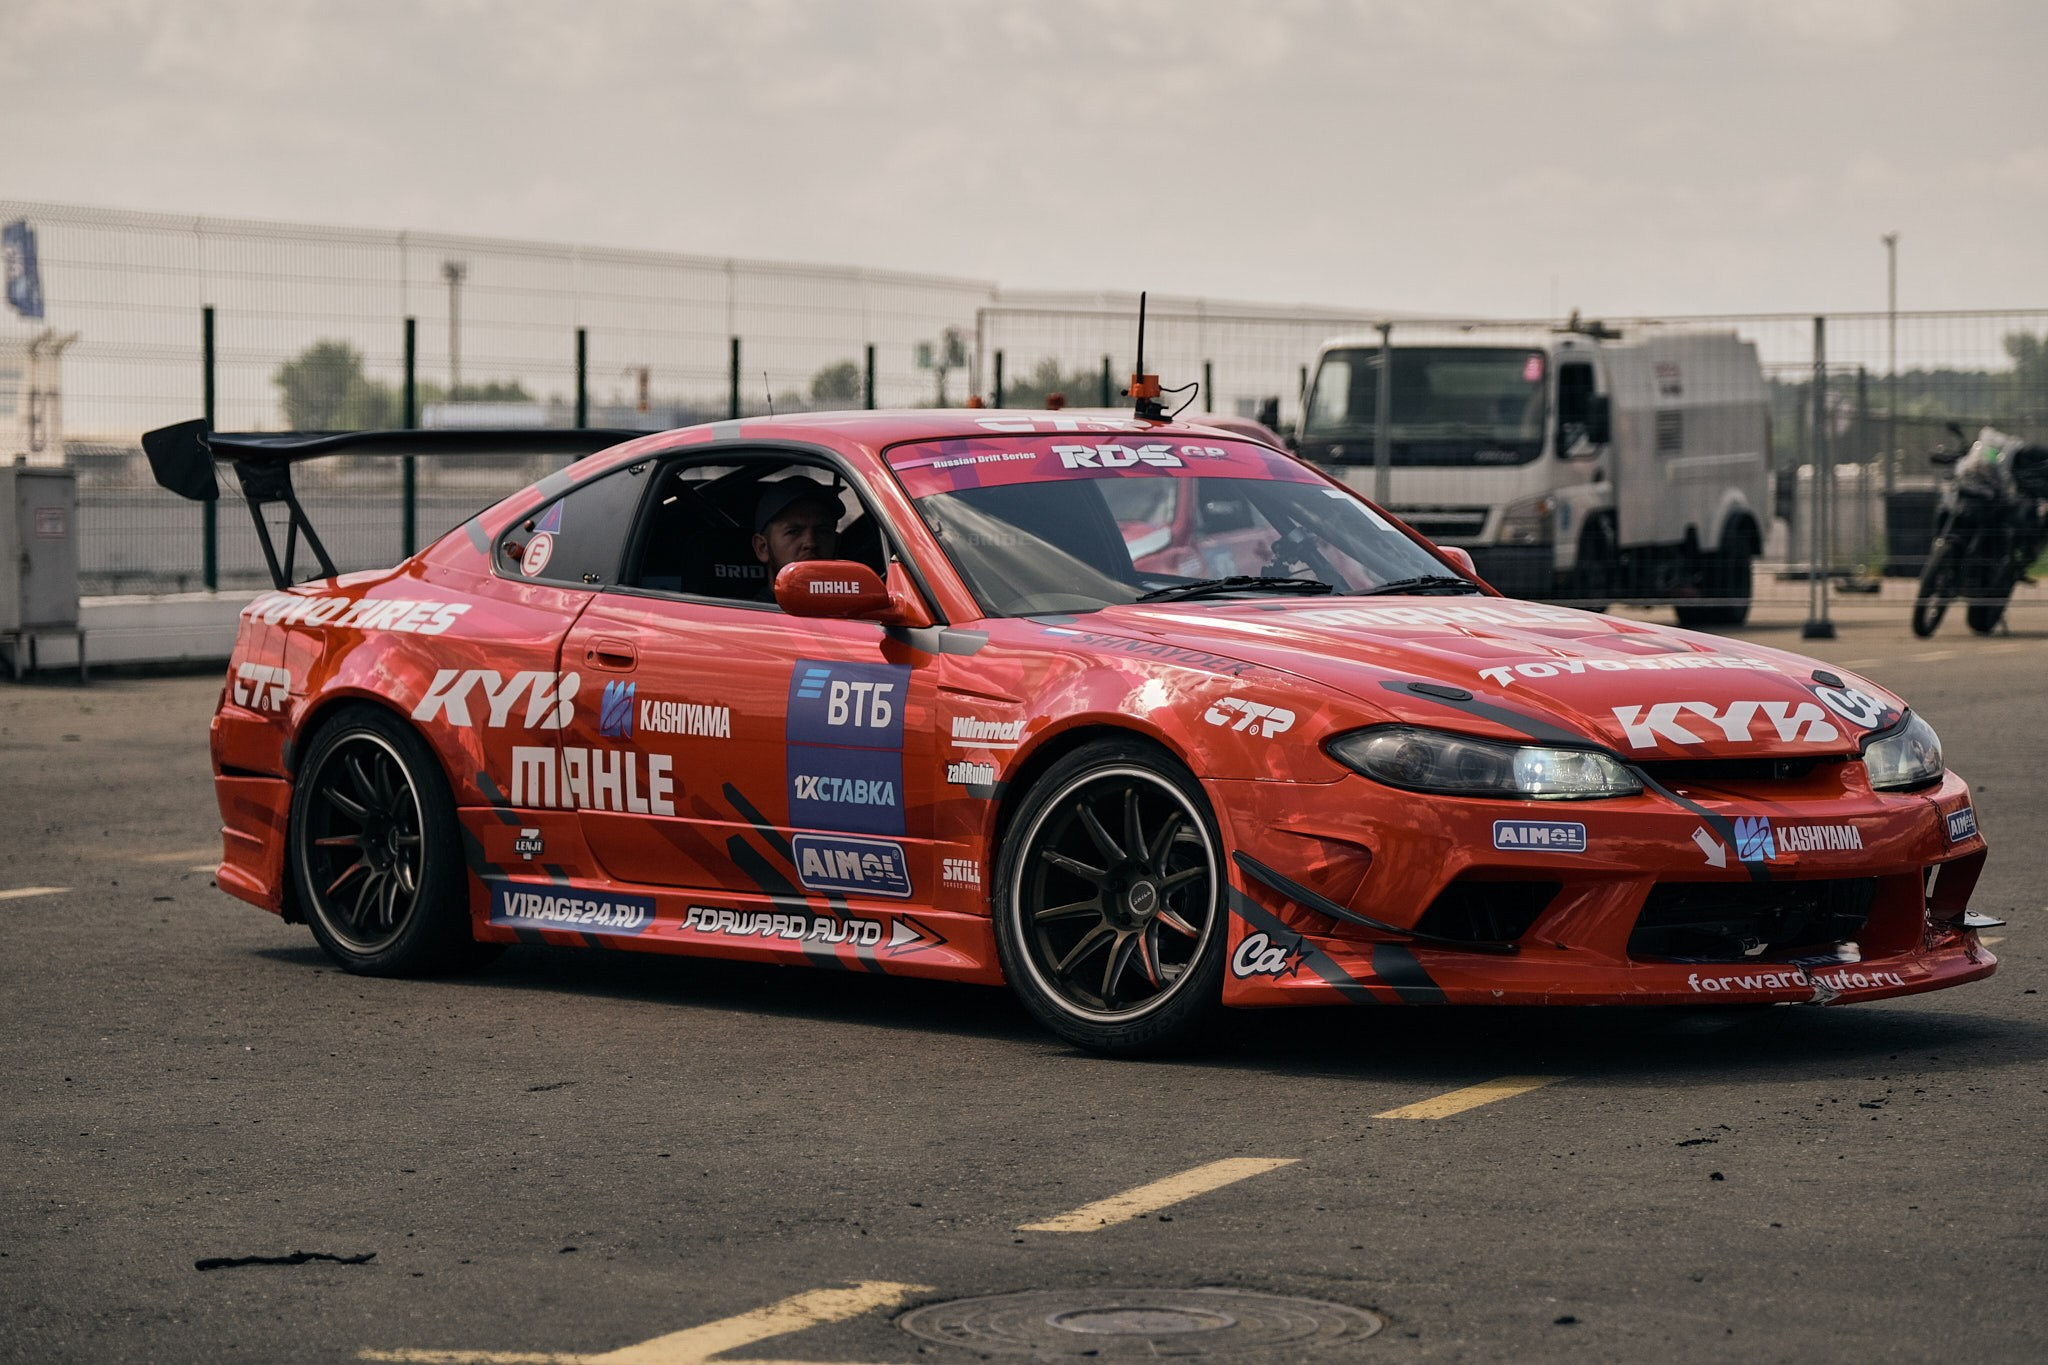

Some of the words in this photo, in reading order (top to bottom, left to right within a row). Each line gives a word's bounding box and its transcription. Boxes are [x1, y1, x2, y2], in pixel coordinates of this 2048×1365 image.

[933, 458, 976, 469] Russian
[977, 454, 1001, 464] Drift
[1002, 451, 1036, 462] Series
[1051, 445, 1183, 469] RDS
[714, 563, 765, 579] BRID
[809, 581, 860, 595] MAHLE
[333, 599, 472, 635] TIRES
[1286, 606, 1594, 625] MAHLE
[1072, 633, 1256, 675] SHNAYDER
[1478, 659, 1630, 688] TOYO
[1627, 656, 1781, 672] TIRES
[411, 669, 581, 730] KYB
[827, 680, 894, 729] ВТБ
[640, 699, 731, 739] KASHIYAMA
[1611, 700, 1839, 749] KYB
[511, 746, 675, 817] MAHLE
[947, 762, 994, 786] zaRRubin
[515, 841, 542, 852] LENJI
[1498, 826, 1582, 846] AIMOL
[1777, 825, 1863, 852] KASHIYAMA
[803, 848, 905, 886] AIMOL
[943, 859, 981, 884] SKILL
[502, 891, 645, 929] VIRAGE24.RU
[682, 908, 807, 941] FORWARD
[807, 918, 882, 946] AUTO
